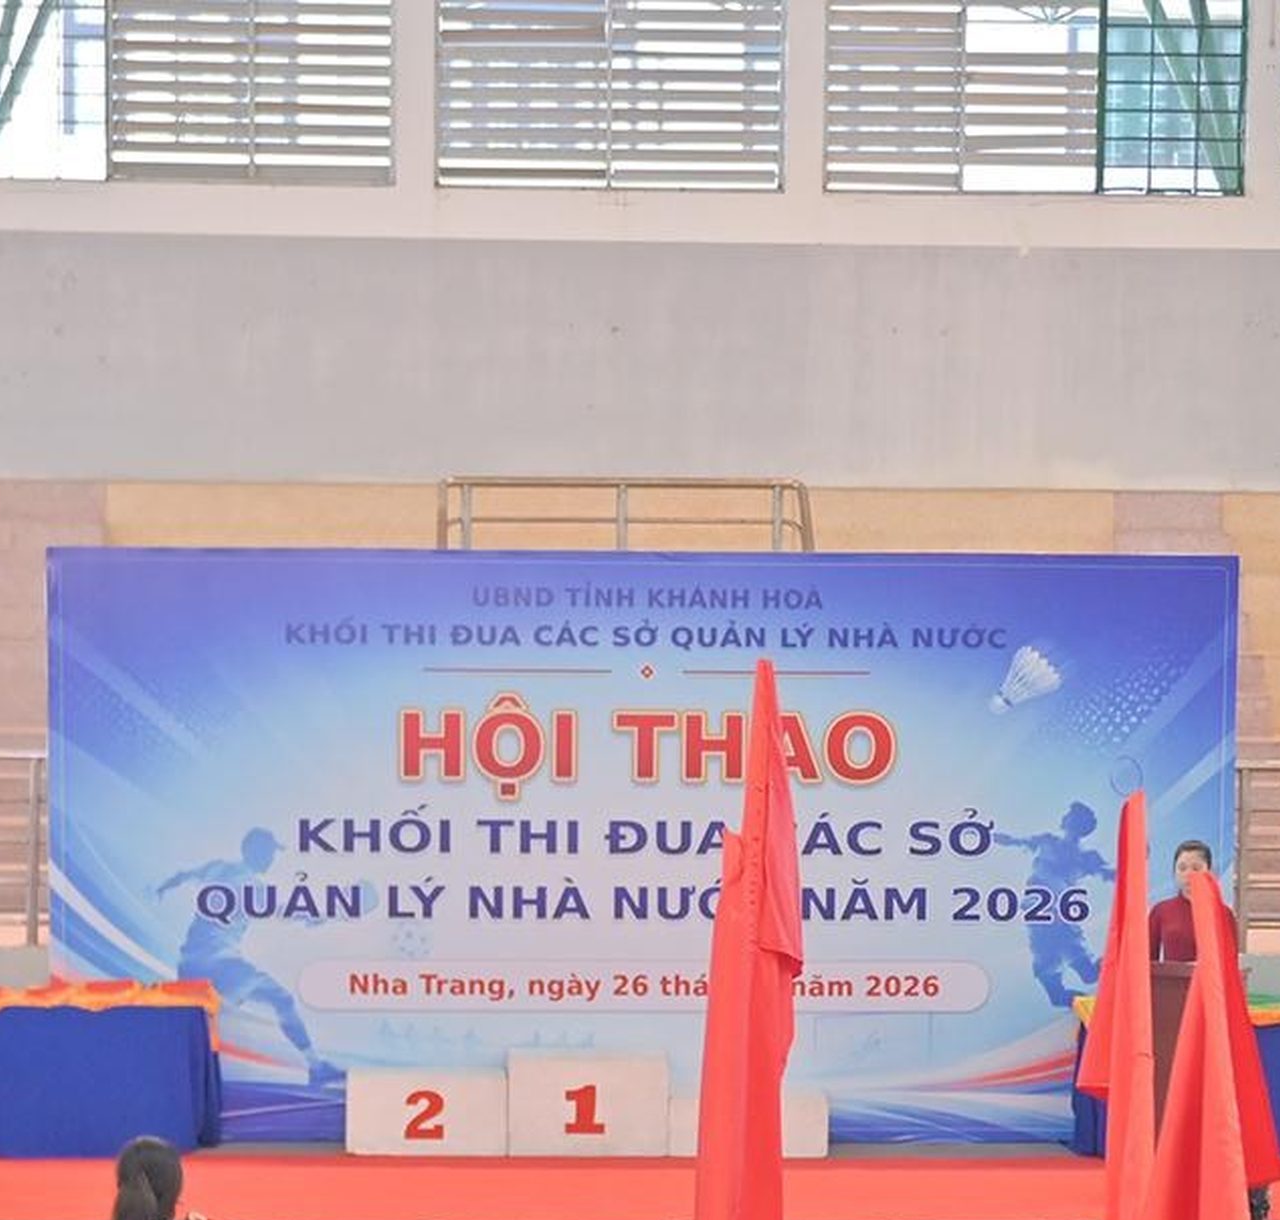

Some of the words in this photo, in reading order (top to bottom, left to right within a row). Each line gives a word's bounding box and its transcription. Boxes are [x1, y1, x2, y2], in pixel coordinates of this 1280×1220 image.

[472, 586, 555, 607] UBND
[647, 582, 750, 609] KHÁNH
[284, 615, 368, 646] KHỐI
[380, 623, 437, 646] THI
[449, 623, 521, 647] ĐUA
[533, 618, 599, 648] CÁC
[612, 617, 659, 648] SỞ
[670, 618, 766, 650] QUẢN
[780, 621, 815, 649] LÝ
[827, 620, 899, 649] NHÀ
[911, 620, 1008, 650] NƯỚC
[399, 692, 578, 801] HỘI
[297, 804, 452, 854] KHỐI
[476, 819, 580, 855] THI
[801, 812, 883, 857] ÁC
[908, 808, 995, 857] SỞ
[196, 871, 361, 925] QUẢN
[387, 876, 447, 920] LÝ
[467, 876, 592, 920] NHÀ
[801, 878, 927, 922] NĂM
[951, 887, 1091, 922] 2026
[348, 973, 408, 996] Nha
[419, 973, 516, 1001] Trang,
[527, 973, 601, 1001] ngày
[612, 974, 649, 996] 26
[659, 973, 708, 997] thá
[791, 975, 853, 997] năm
[865, 975, 940, 997] 2026
[403, 1089, 445, 1140] 2
[564, 1084, 606, 1135] 1
